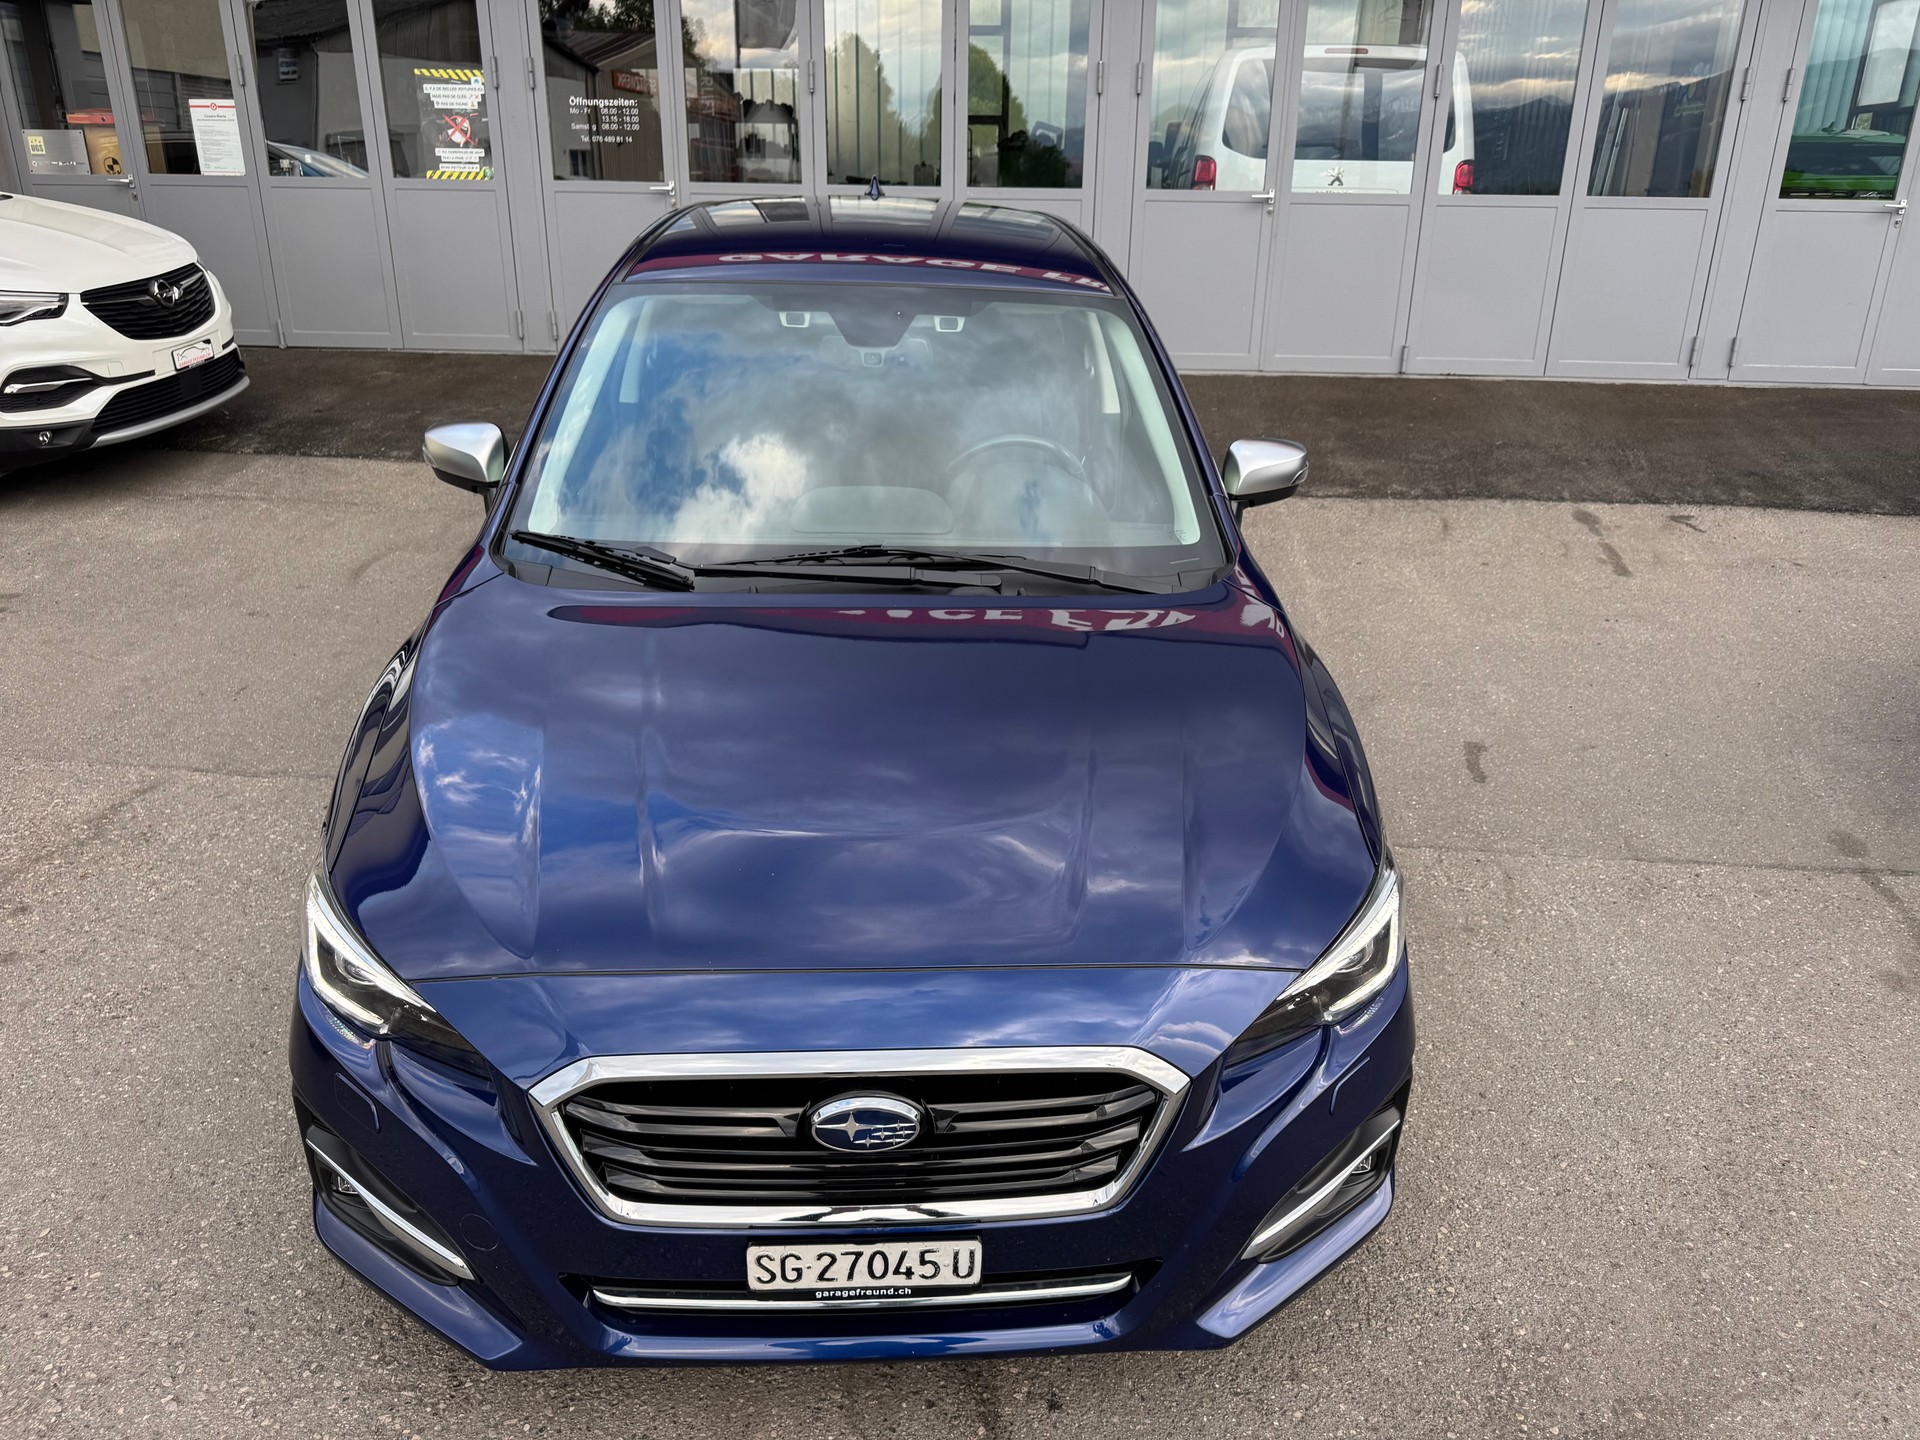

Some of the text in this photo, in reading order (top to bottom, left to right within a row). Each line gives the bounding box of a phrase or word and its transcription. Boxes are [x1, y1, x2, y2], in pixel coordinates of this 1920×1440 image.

[569, 95, 638, 108] Öffnungszeiten:
[600, 107, 618, 115] 08.00
[622, 107, 639, 115] 12.00
[571, 122, 597, 131] Samstg
[625, 135, 633, 143] 14
[815, 1287, 912, 1299] garagefreund.ch
